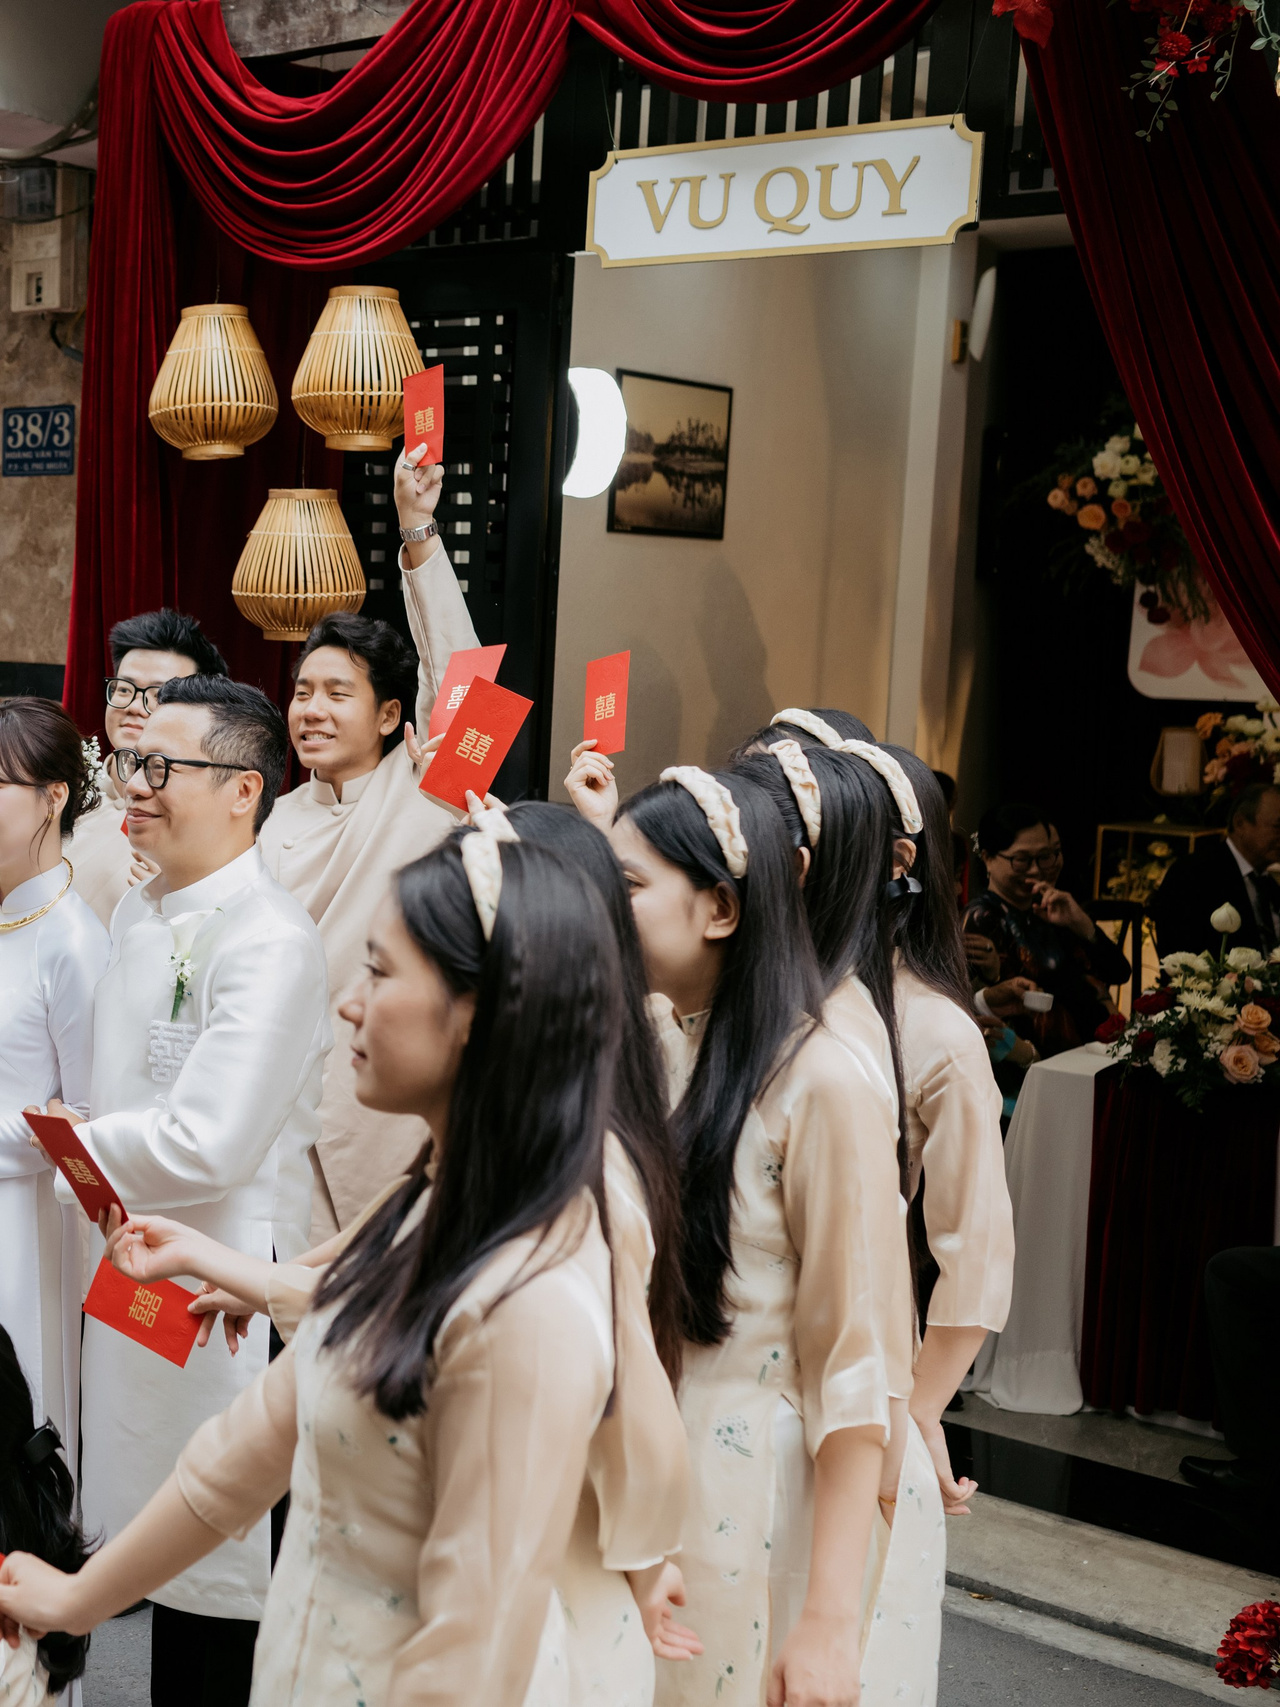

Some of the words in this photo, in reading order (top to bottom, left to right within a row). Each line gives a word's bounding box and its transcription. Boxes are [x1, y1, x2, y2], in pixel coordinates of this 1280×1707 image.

[636, 171, 736, 234] VU
[753, 154, 921, 235] QUY
[7, 409, 71, 449] 38/3
